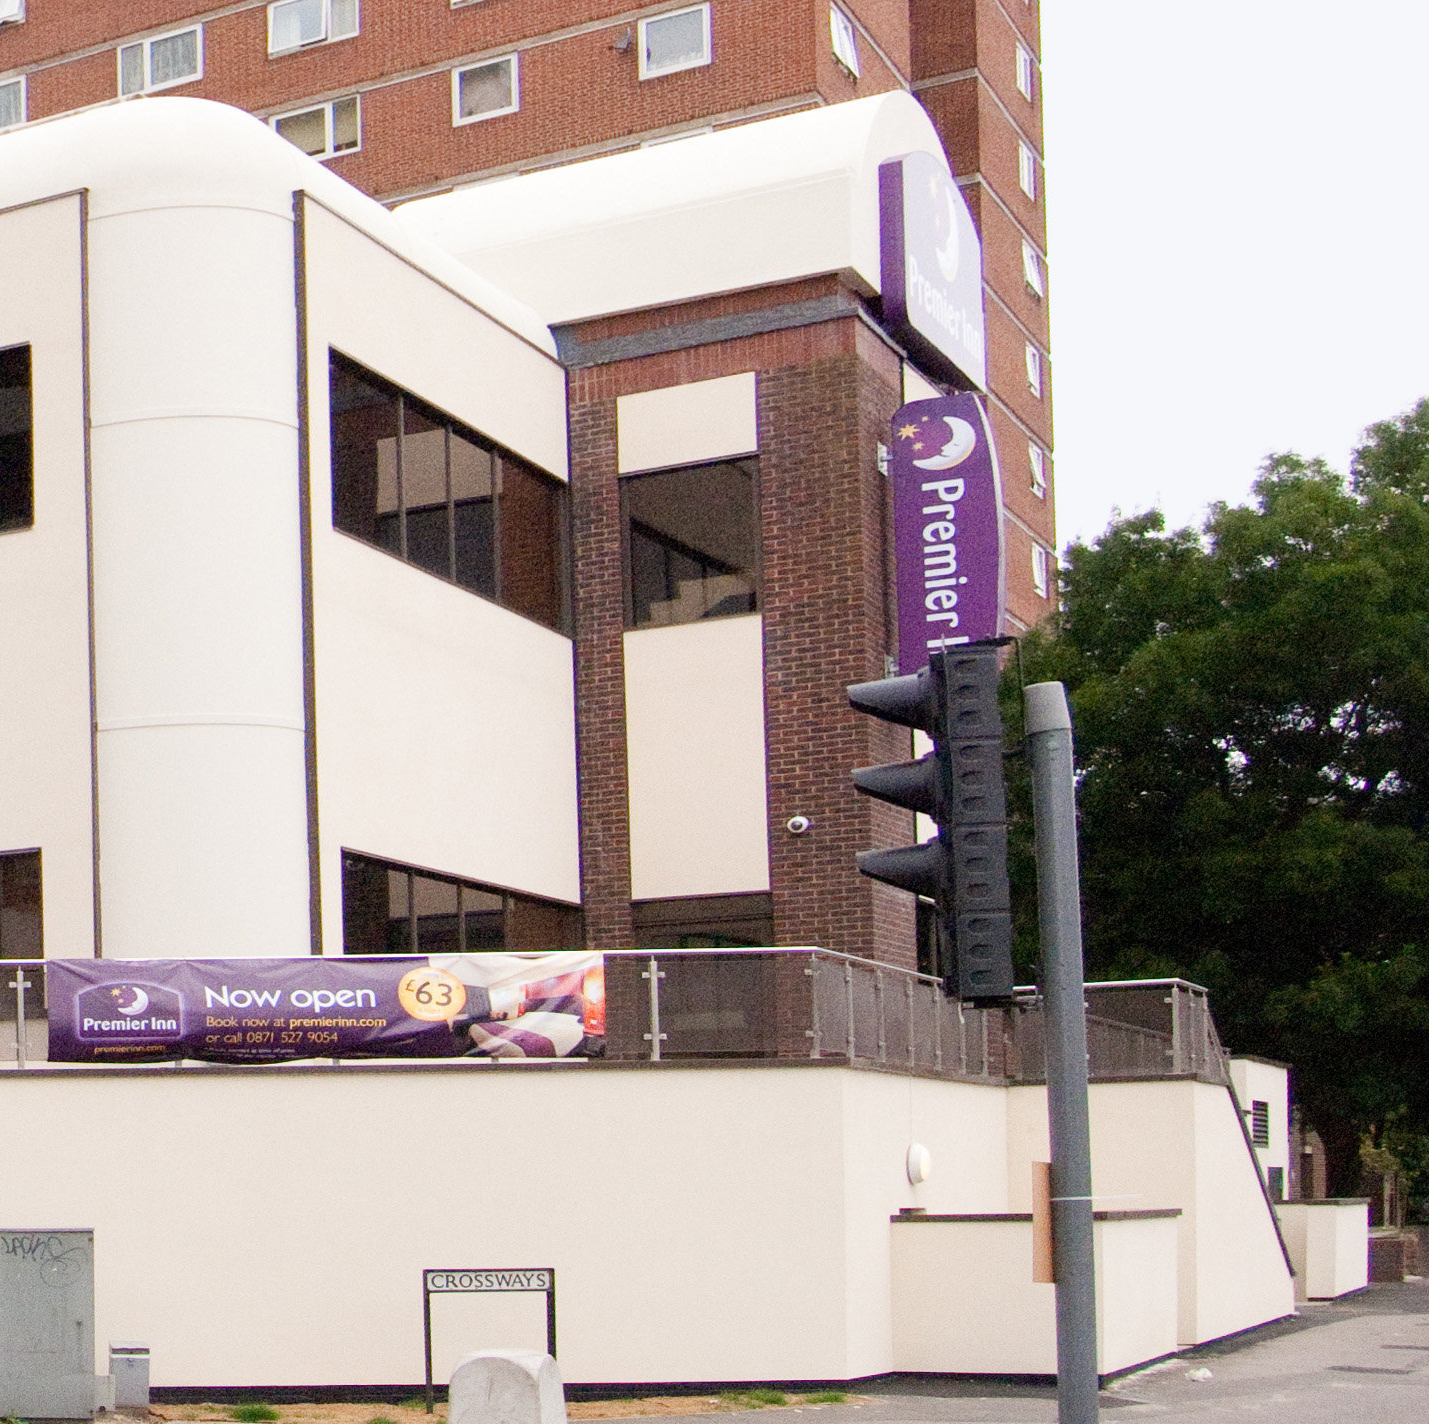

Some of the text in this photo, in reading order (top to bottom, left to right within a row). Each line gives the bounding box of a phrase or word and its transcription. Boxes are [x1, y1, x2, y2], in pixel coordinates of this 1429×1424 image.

[909, 255, 983, 364] Premier Inn
[921, 478, 969, 629] Premier
[204, 985, 377, 1013] Now open
[405, 979, 452, 1007] £63
[83, 1017, 178, 1031] Premier Inn
[206, 1016, 387, 1030] Book now at premierinn.com
[206, 1031, 338, 1044] or call 0871 527 9054
[94, 1044, 166, 1055] premierinn.com
[431, 1272, 546, 1288] CROSSWAYS
